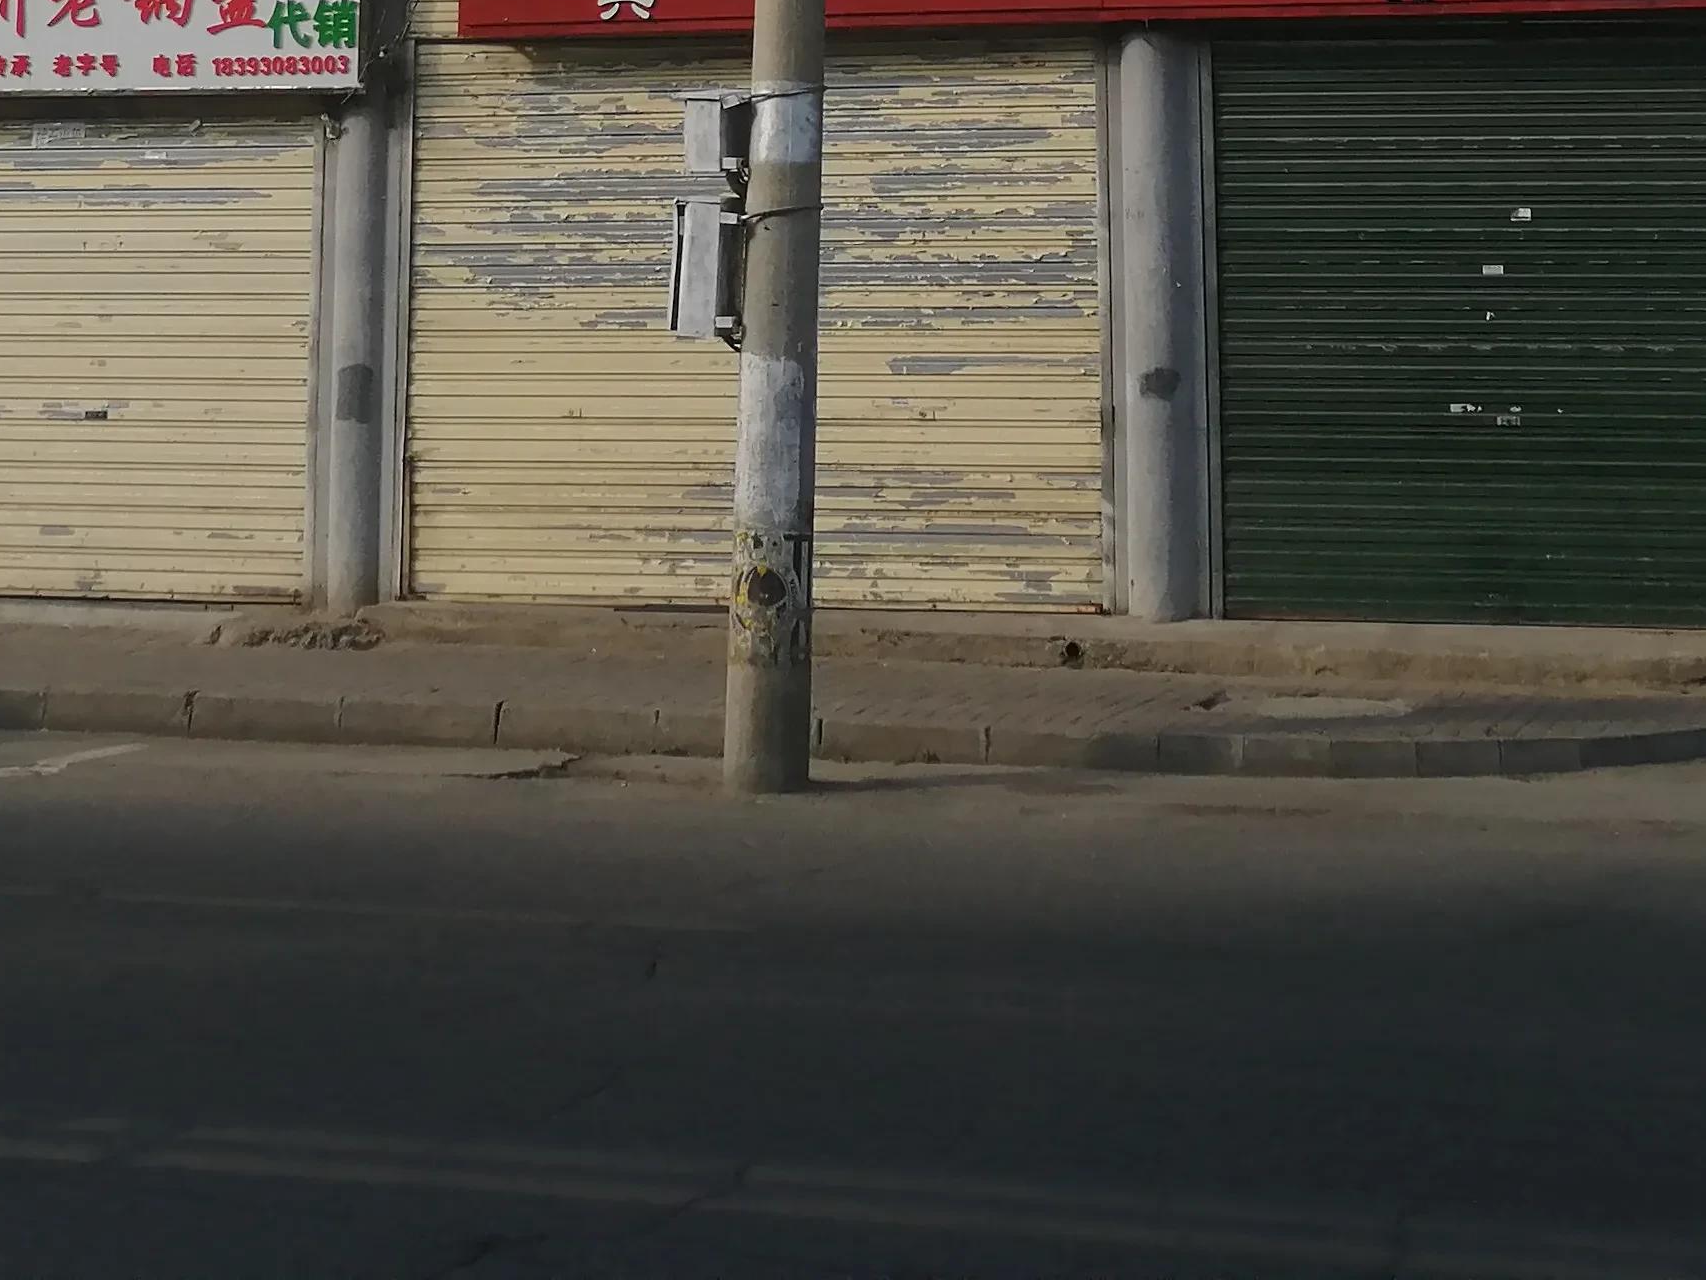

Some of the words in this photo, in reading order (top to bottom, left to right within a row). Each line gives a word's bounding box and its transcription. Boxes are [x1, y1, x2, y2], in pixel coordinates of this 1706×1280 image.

[267, 0, 359, 49] 代销
[53, 53, 121, 78] 老字号
